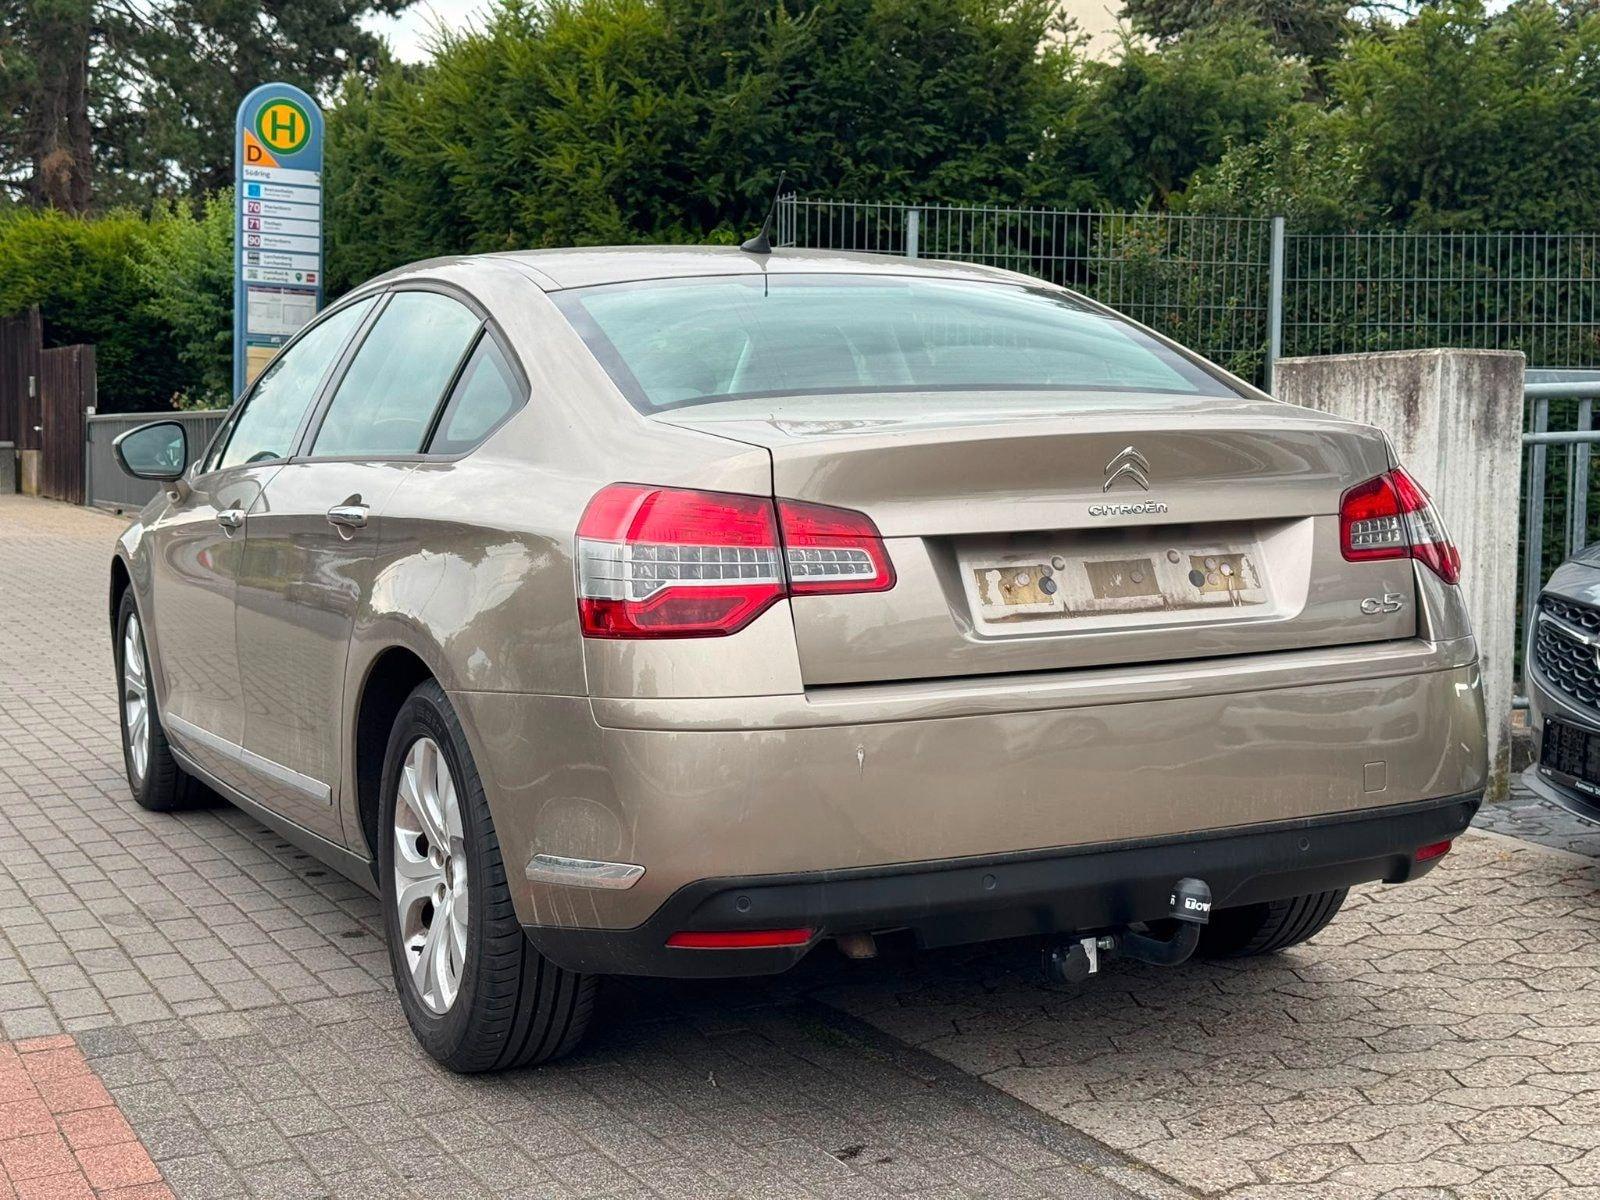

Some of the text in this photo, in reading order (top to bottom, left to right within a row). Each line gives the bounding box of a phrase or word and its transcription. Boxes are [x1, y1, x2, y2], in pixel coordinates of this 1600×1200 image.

[271, 110, 296, 143] H
[247, 145, 262, 162] D
[245, 169, 271, 179] Südring
[249, 202, 260, 213] 70
[249, 219, 260, 229] 71
[248, 235, 260, 246] 90
[1360, 592, 1402, 615] C5
